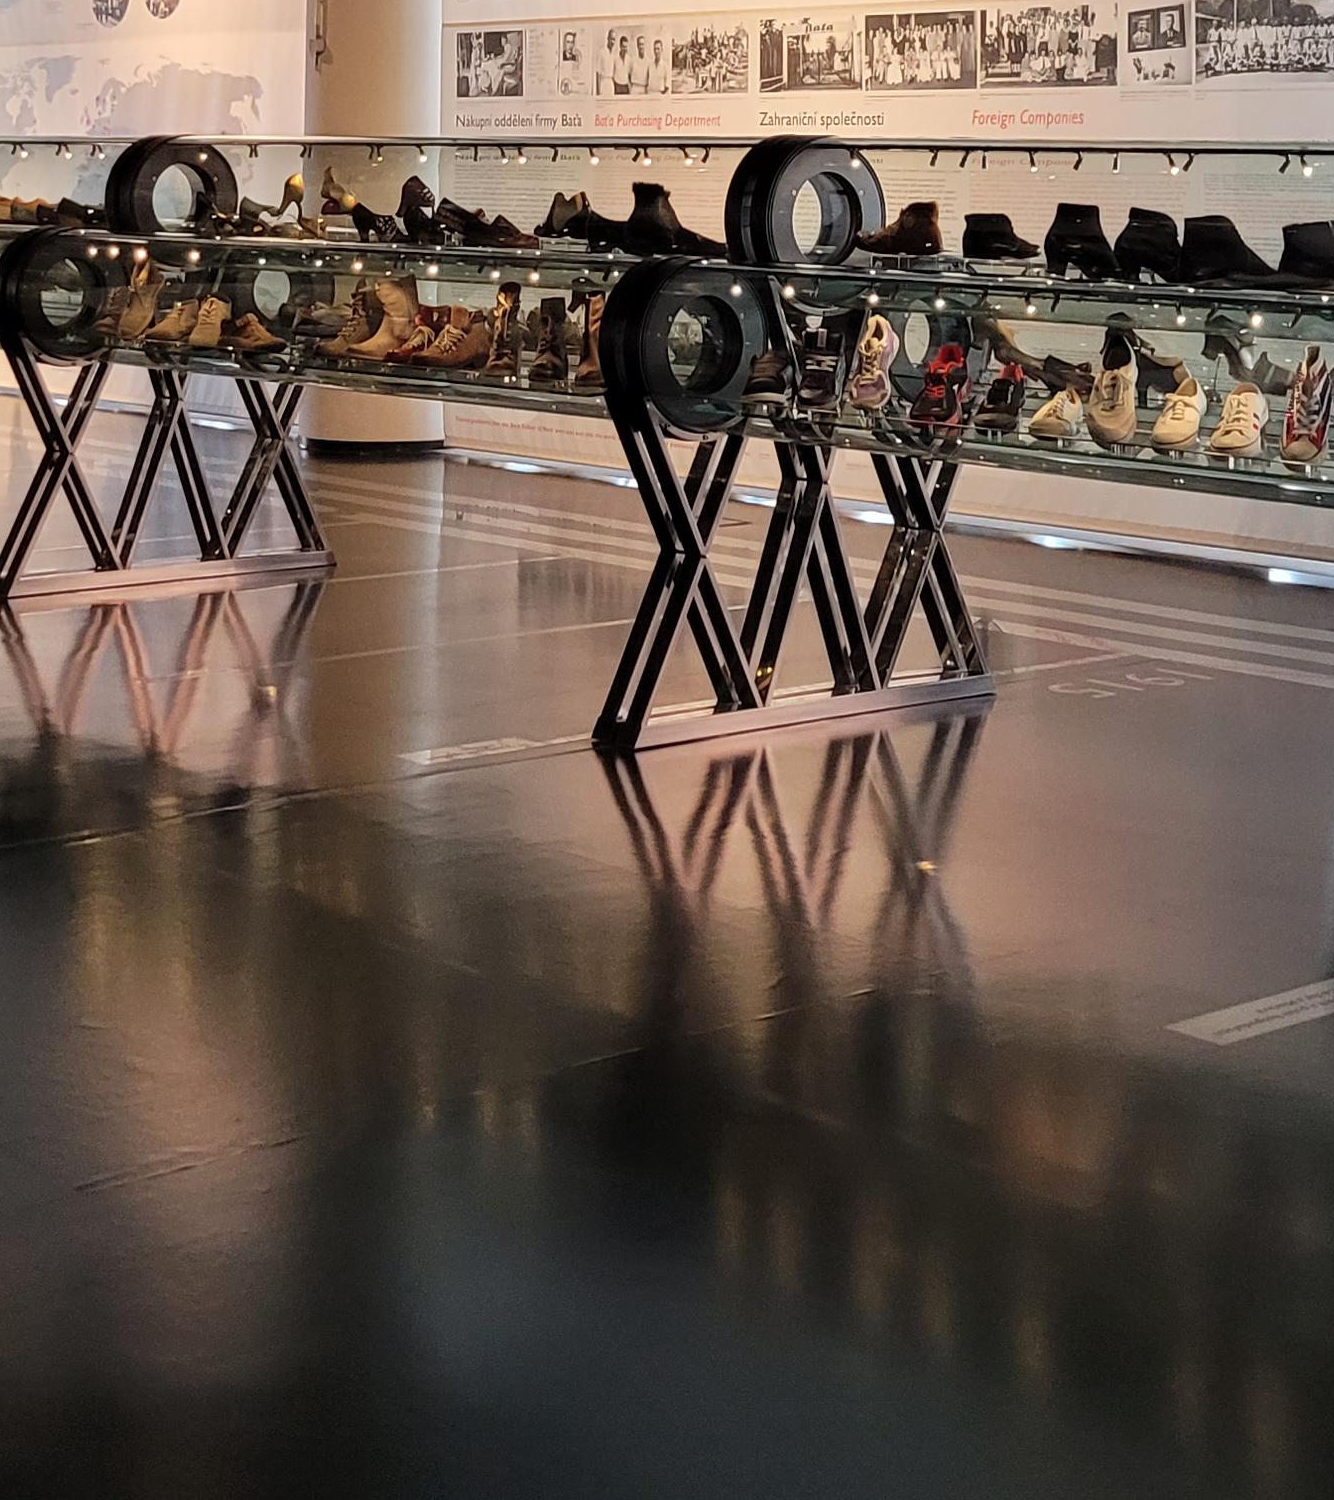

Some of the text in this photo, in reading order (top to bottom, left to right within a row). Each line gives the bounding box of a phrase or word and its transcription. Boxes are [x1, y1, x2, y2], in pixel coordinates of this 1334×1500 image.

[455, 113, 492, 131] Nákupní
[494, 113, 534, 128] oddělení
[535, 113, 558, 131] firmy
[561, 113, 582, 128] Baťa
[616, 113, 662, 131] Purchasing
[665, 113, 721, 130] Department
[759, 109, 1085, 131] Zahraniční společnosti Foreign Companies
